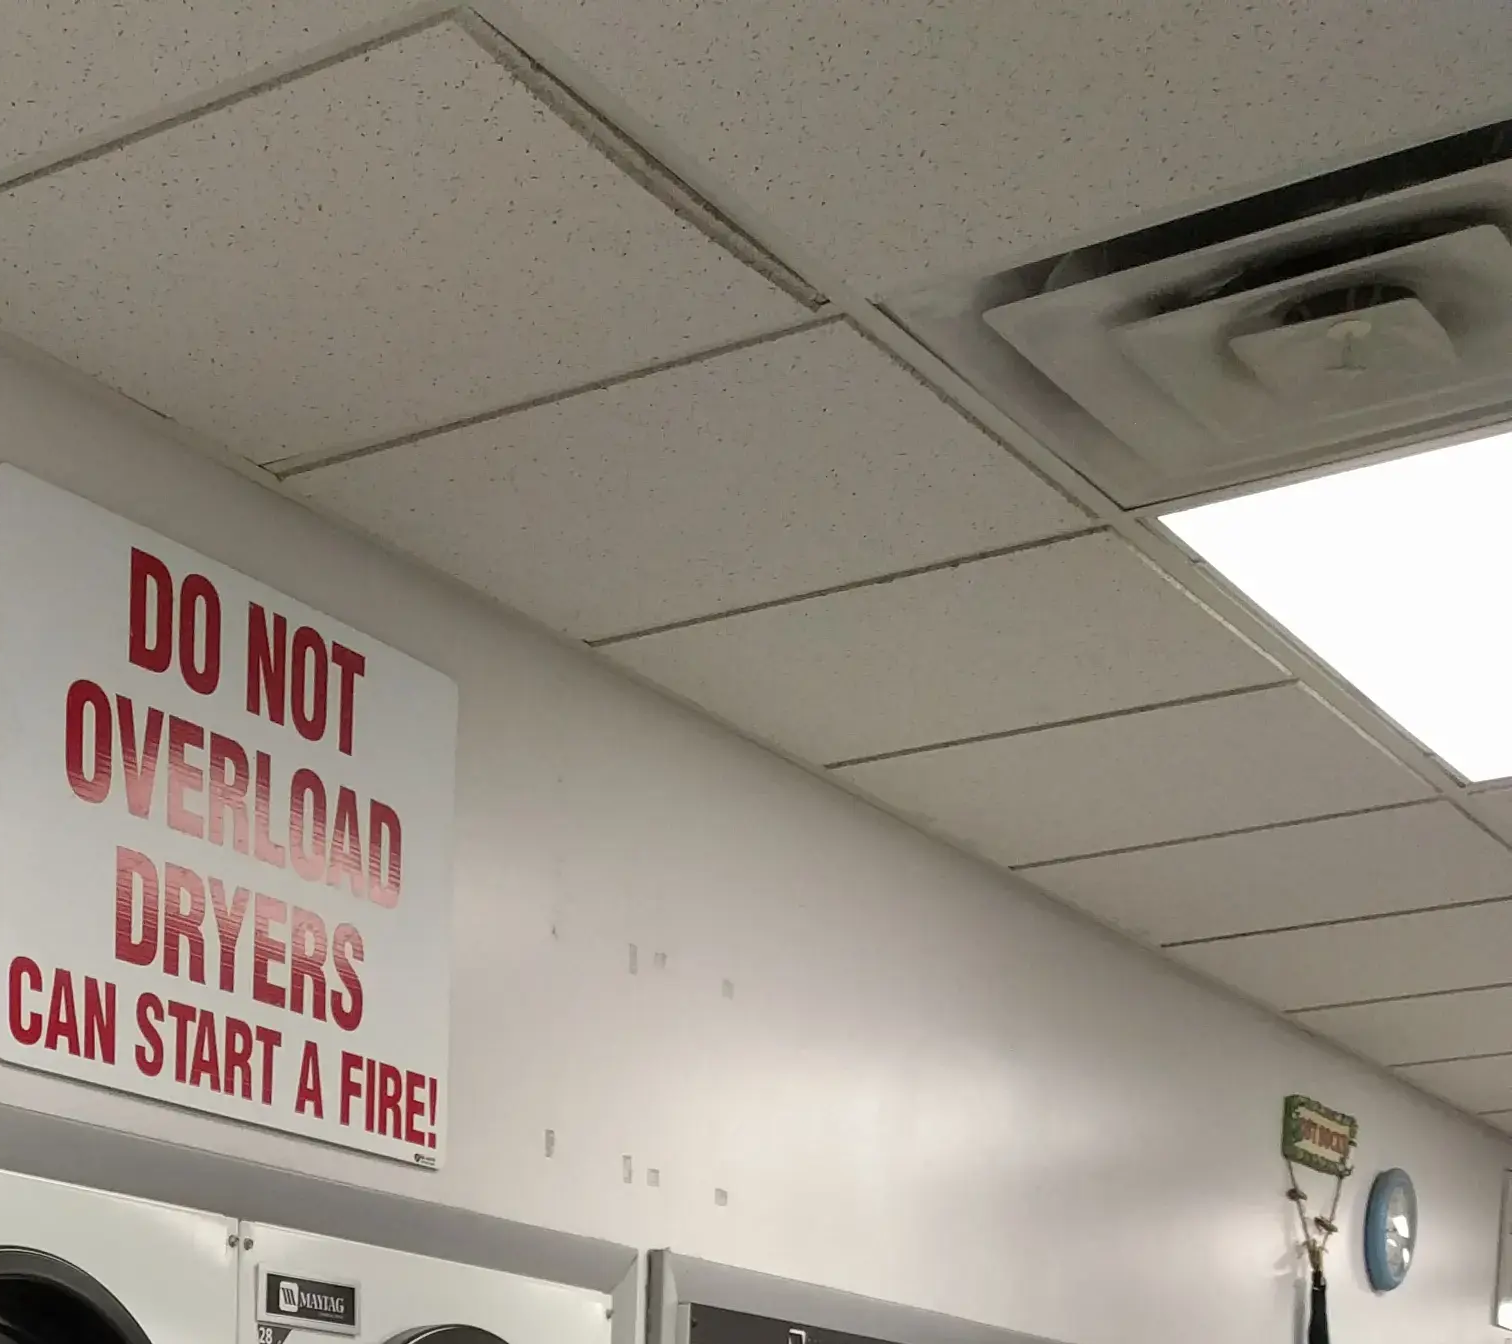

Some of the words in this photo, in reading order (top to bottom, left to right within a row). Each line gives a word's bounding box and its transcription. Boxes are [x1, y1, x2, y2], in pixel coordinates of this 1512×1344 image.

[128, 546, 222, 695] DO
[245, 602, 366, 755] NOT
[64, 679, 403, 908] OVERLOAD
[114, 846, 365, 1033] DRYERS
[7, 955, 117, 1066] CAN
[134, 991, 283, 1107] START
[295, 1040, 325, 1120] A
[339, 1049, 438, 1150] FIRE!
[259, 1327, 273, 1344] 28
[299, 1291, 345, 1314] MAYTAG
